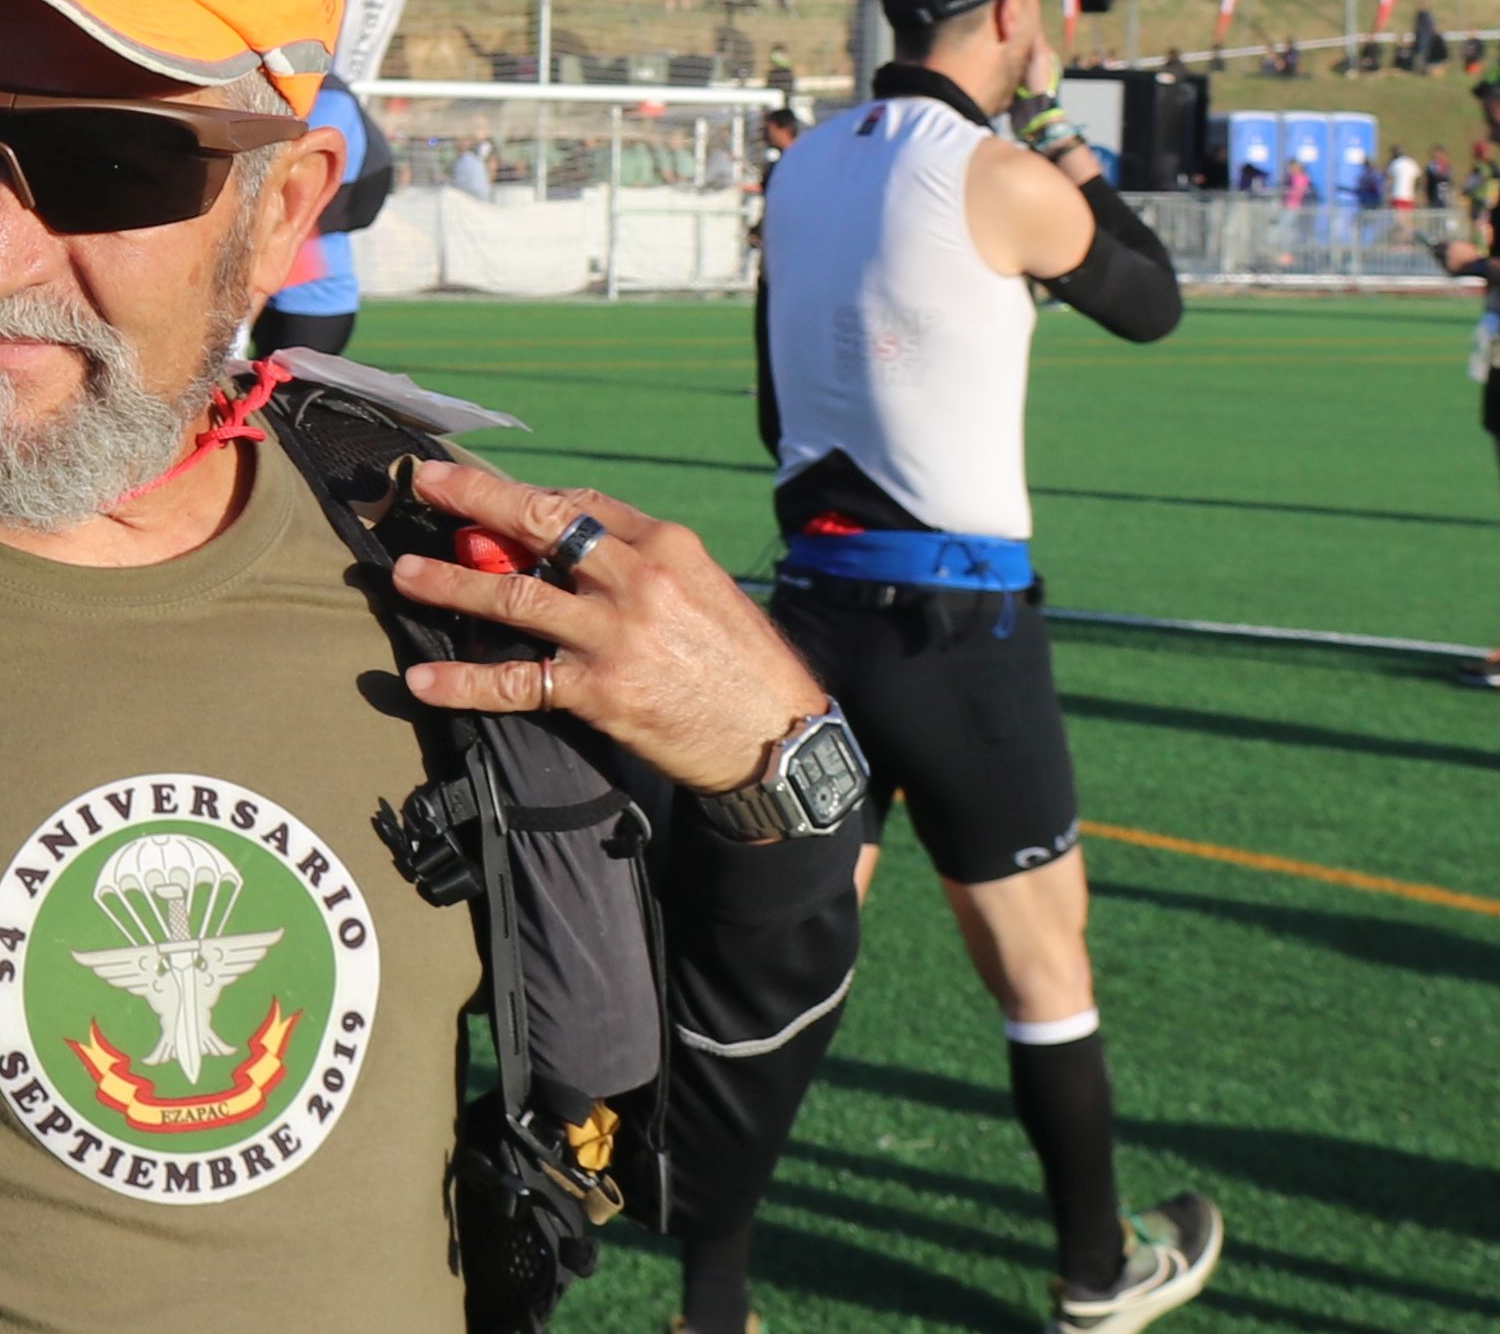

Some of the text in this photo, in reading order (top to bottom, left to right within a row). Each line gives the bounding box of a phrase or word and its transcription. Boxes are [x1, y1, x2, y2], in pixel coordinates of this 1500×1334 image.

[15, 783, 368, 951] ANIVERSARIO
[160, 1101, 231, 1126] EZAPAC
[306, 1010, 366, 1125] 2019
